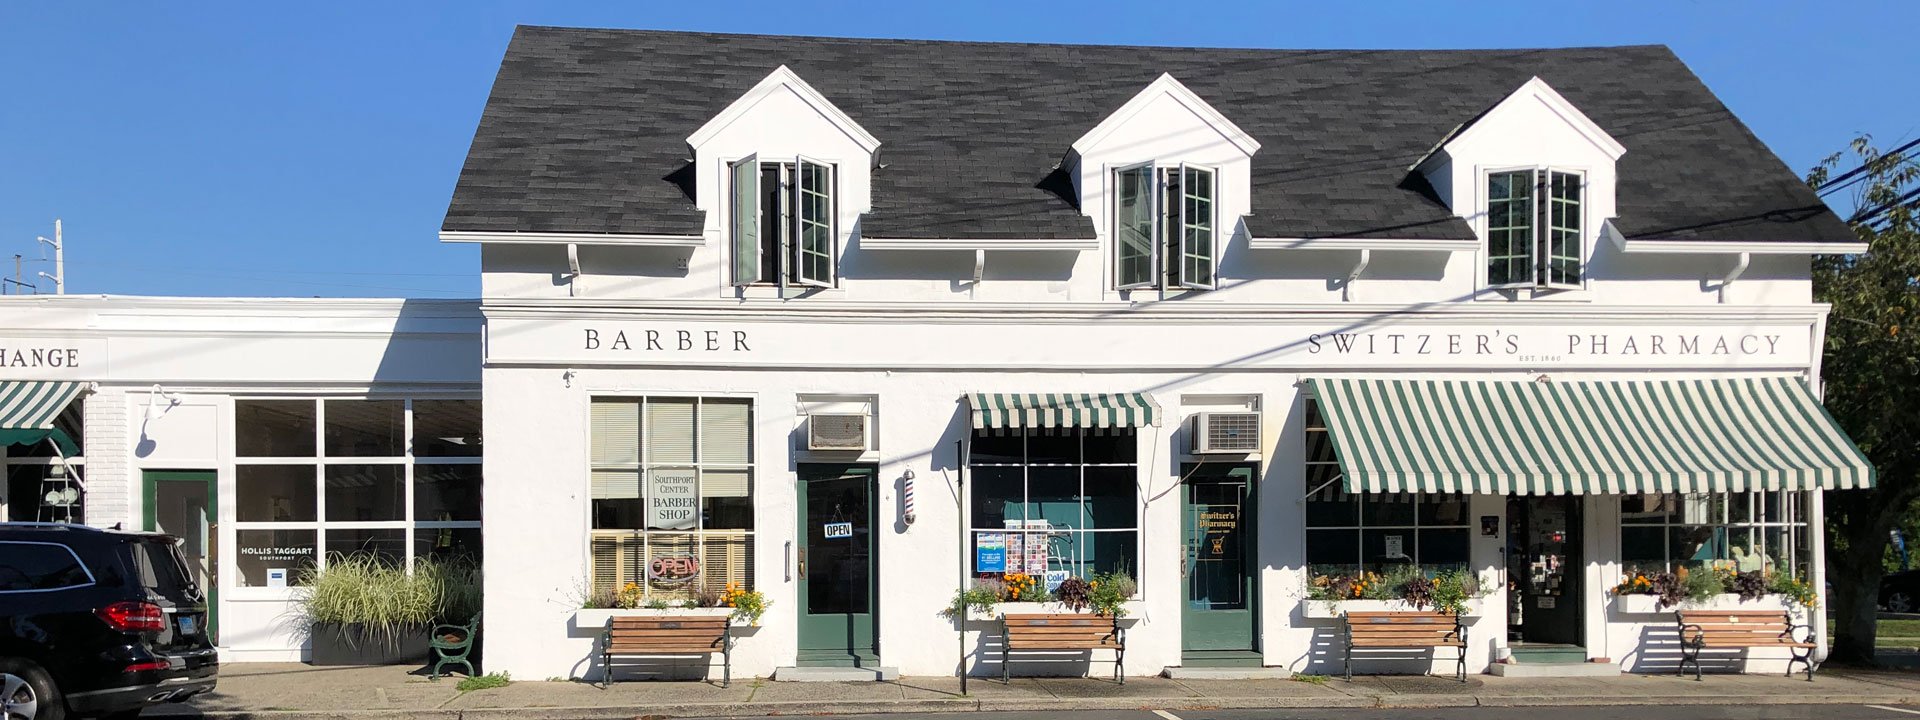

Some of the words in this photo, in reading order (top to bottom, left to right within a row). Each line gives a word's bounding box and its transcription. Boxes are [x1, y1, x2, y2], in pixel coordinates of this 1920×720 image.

[584, 329, 751, 351] BARBER
[1308, 329, 1519, 354] SWITZER'S
[1567, 334, 1780, 354] PHARMACY
[660, 485, 689, 494] CENTER
[653, 497, 696, 508] BARBER
[659, 509, 690, 520] SHOP
[1199, 519, 1236, 529] Pharmacy
[826, 524, 850, 537] OPEN
[241, 547, 272, 555] HOLLIS
[273, 547, 313, 555] TAGGART
[650, 557, 698, 577] OPEN
[1047, 573, 1065, 583] Cold
